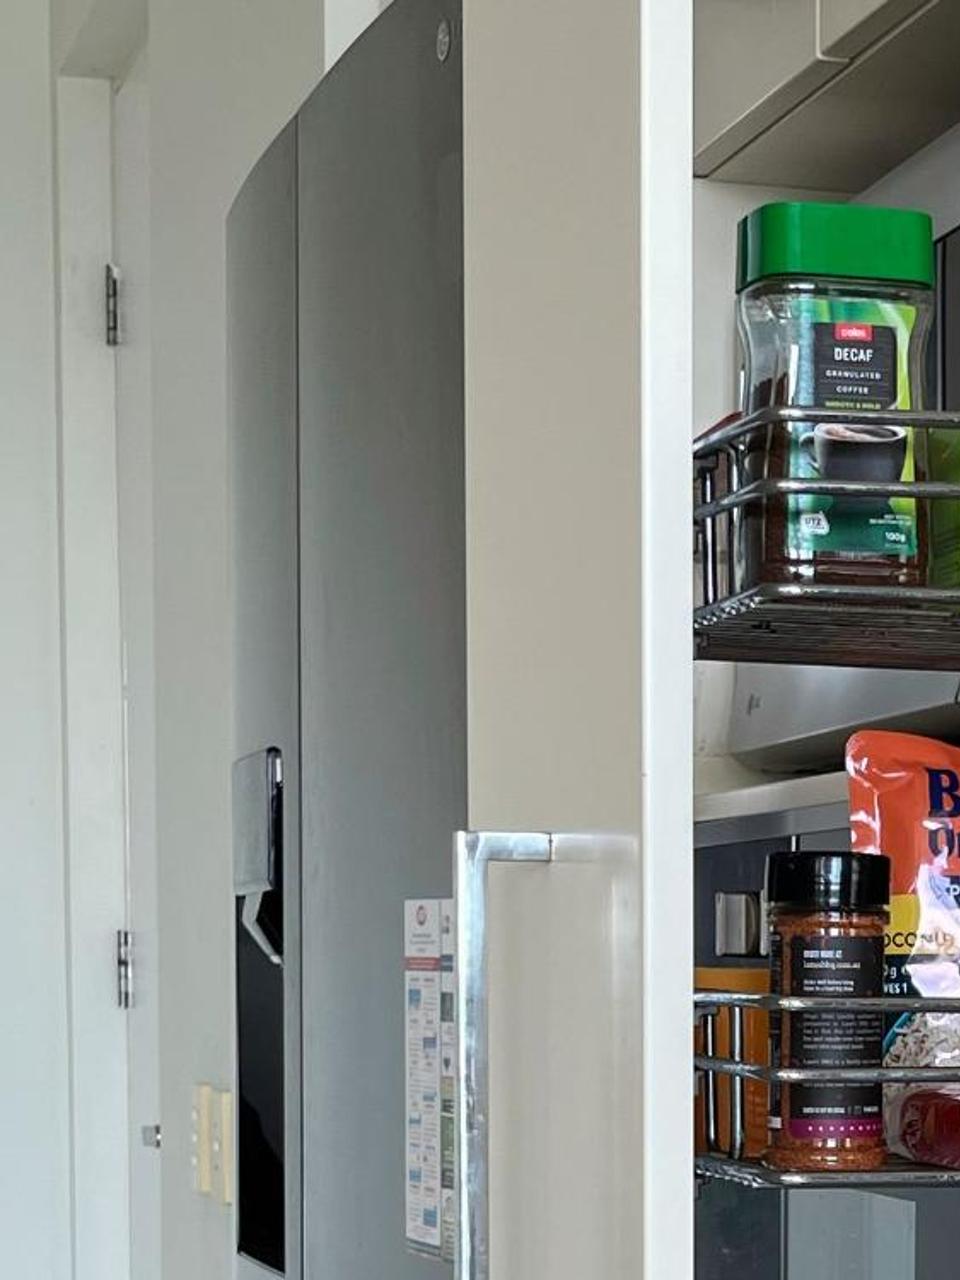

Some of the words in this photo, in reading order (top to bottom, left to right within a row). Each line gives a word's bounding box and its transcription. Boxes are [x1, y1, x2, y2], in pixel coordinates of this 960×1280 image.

[833, 346, 873, 362] DECAF
[825, 369, 882, 380] GRANULATED
[836, 385, 869, 395] COFFEE
